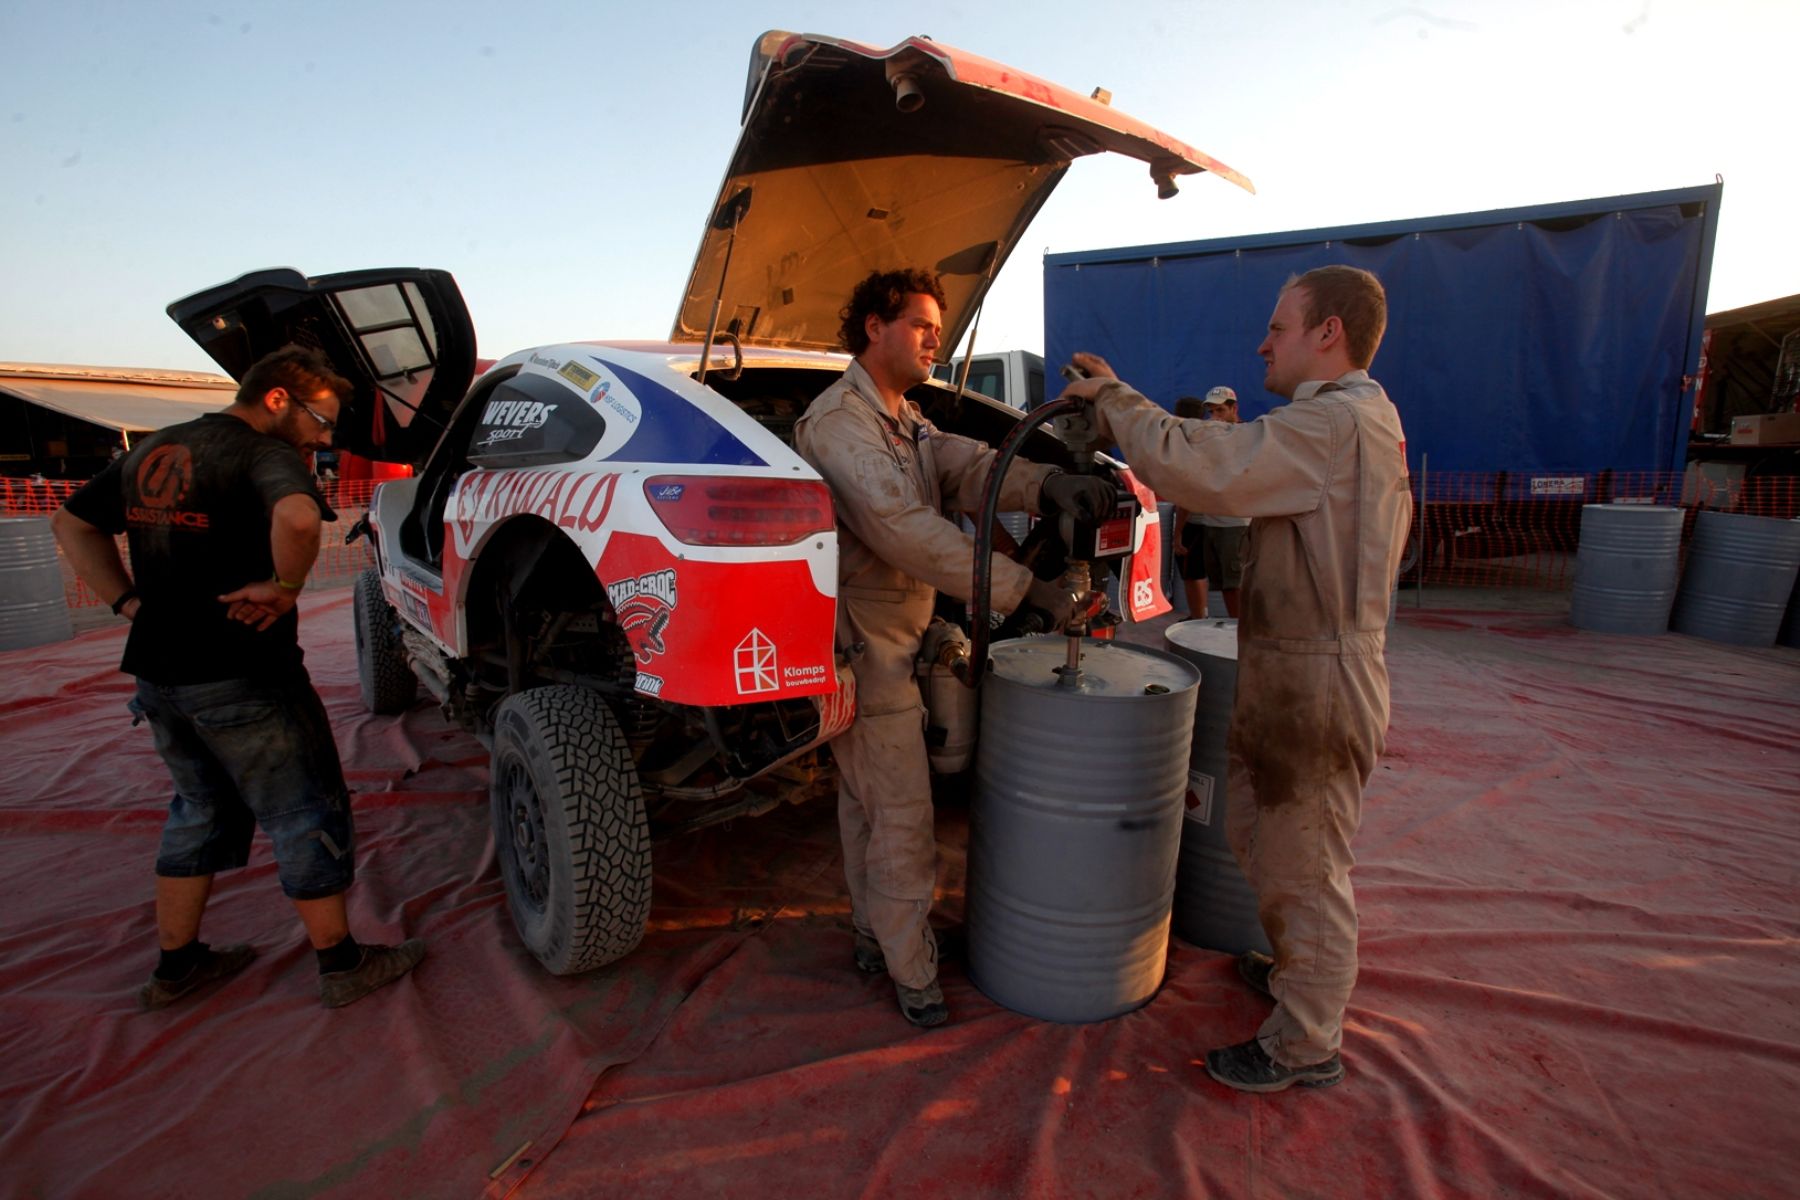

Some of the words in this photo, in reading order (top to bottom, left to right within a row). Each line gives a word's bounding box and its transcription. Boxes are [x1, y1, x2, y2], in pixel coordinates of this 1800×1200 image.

[482, 401, 558, 428] WEVERS
[486, 426, 528, 446] sport
[608, 570, 676, 609] MAD-CROC
[784, 664, 826, 678] Klomps
